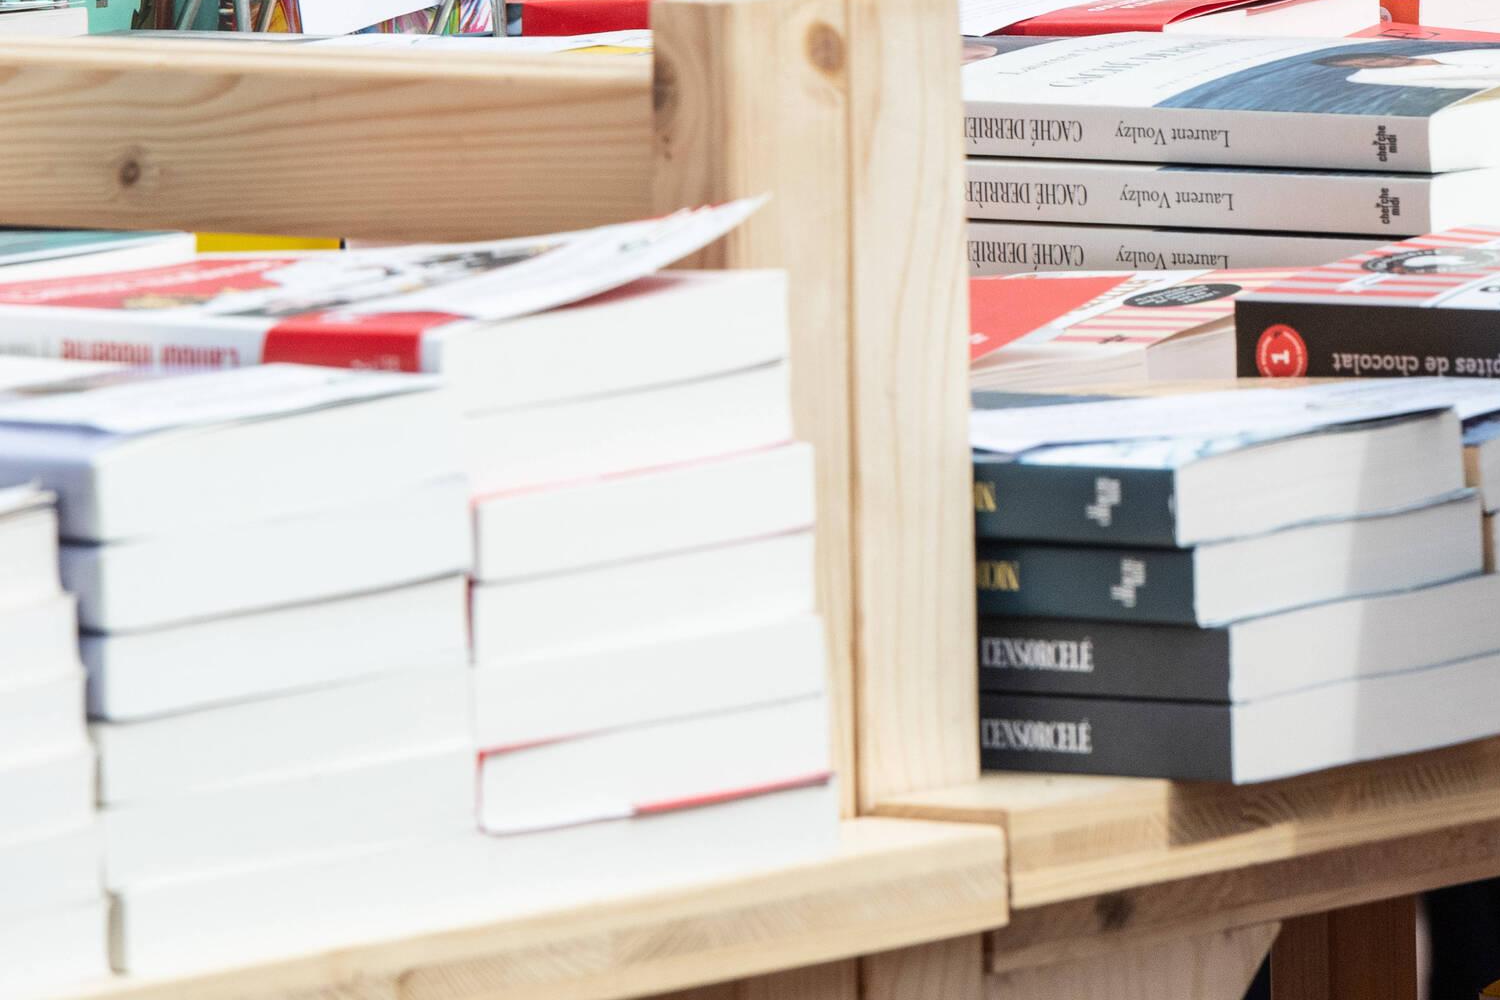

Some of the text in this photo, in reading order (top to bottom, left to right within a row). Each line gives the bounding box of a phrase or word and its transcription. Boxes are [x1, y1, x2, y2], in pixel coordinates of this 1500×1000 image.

[1030, 119, 1083, 147] CACHÉ
[1114, 121, 1167, 146] Voulzy
[1171, 128, 1231, 148] Laurent
[1035, 182, 1088, 210] CACHÉ
[1119, 187, 1172, 210] Voulzy
[1175, 191, 1235, 211] Laurent
[1032, 243, 1085, 271] CACHÉ
[1115, 247, 1167, 270] Voulzy
[1271, 349, 1290, 366] 1
[1331, 352, 1419, 376] chocolat
[1424, 356, 1449, 376] de
